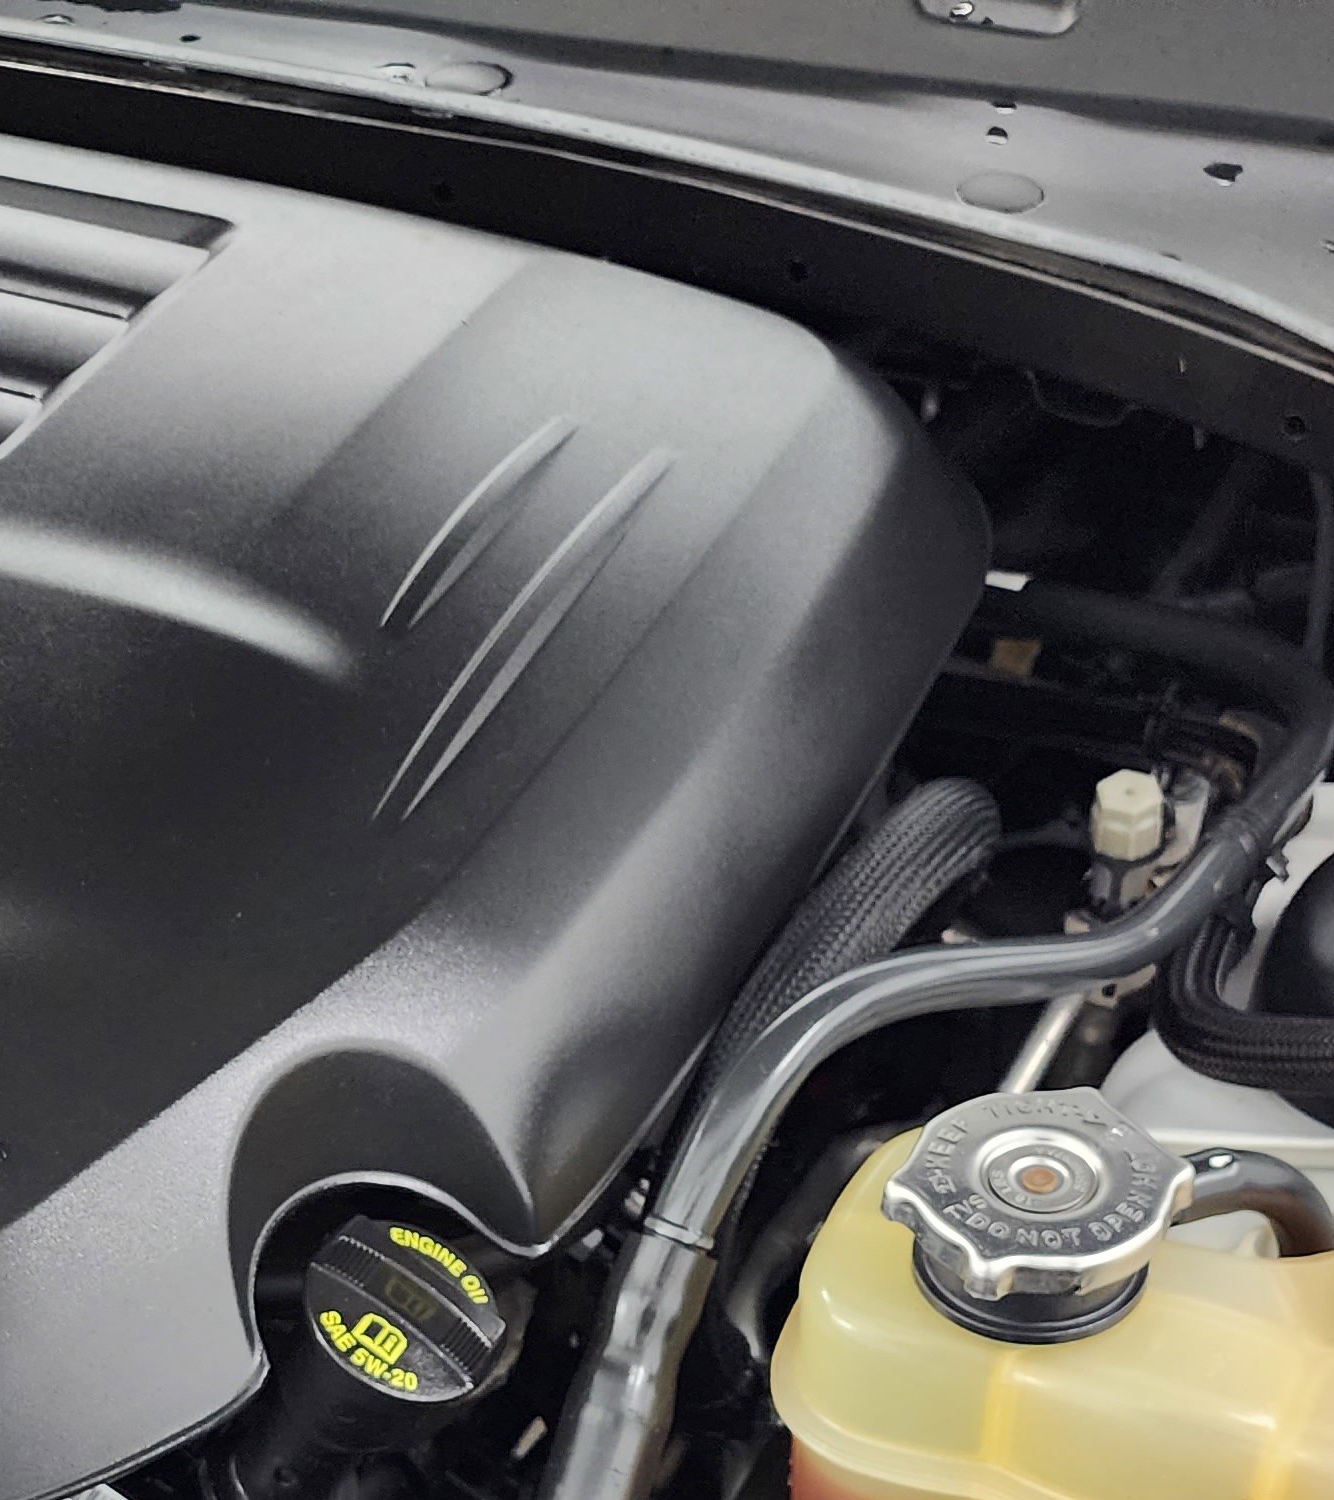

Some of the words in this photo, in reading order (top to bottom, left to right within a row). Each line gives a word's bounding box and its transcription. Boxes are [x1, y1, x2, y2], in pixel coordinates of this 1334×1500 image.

[967, 1215, 1012, 1239] DO
[1017, 1226, 1082, 1250] NOT
[1088, 1190, 1155, 1242] OPEN
[389, 1226, 468, 1278] ENGINE
[319, 1310, 358, 1352] SAE
[349, 1347, 419, 1392] 5W-20
